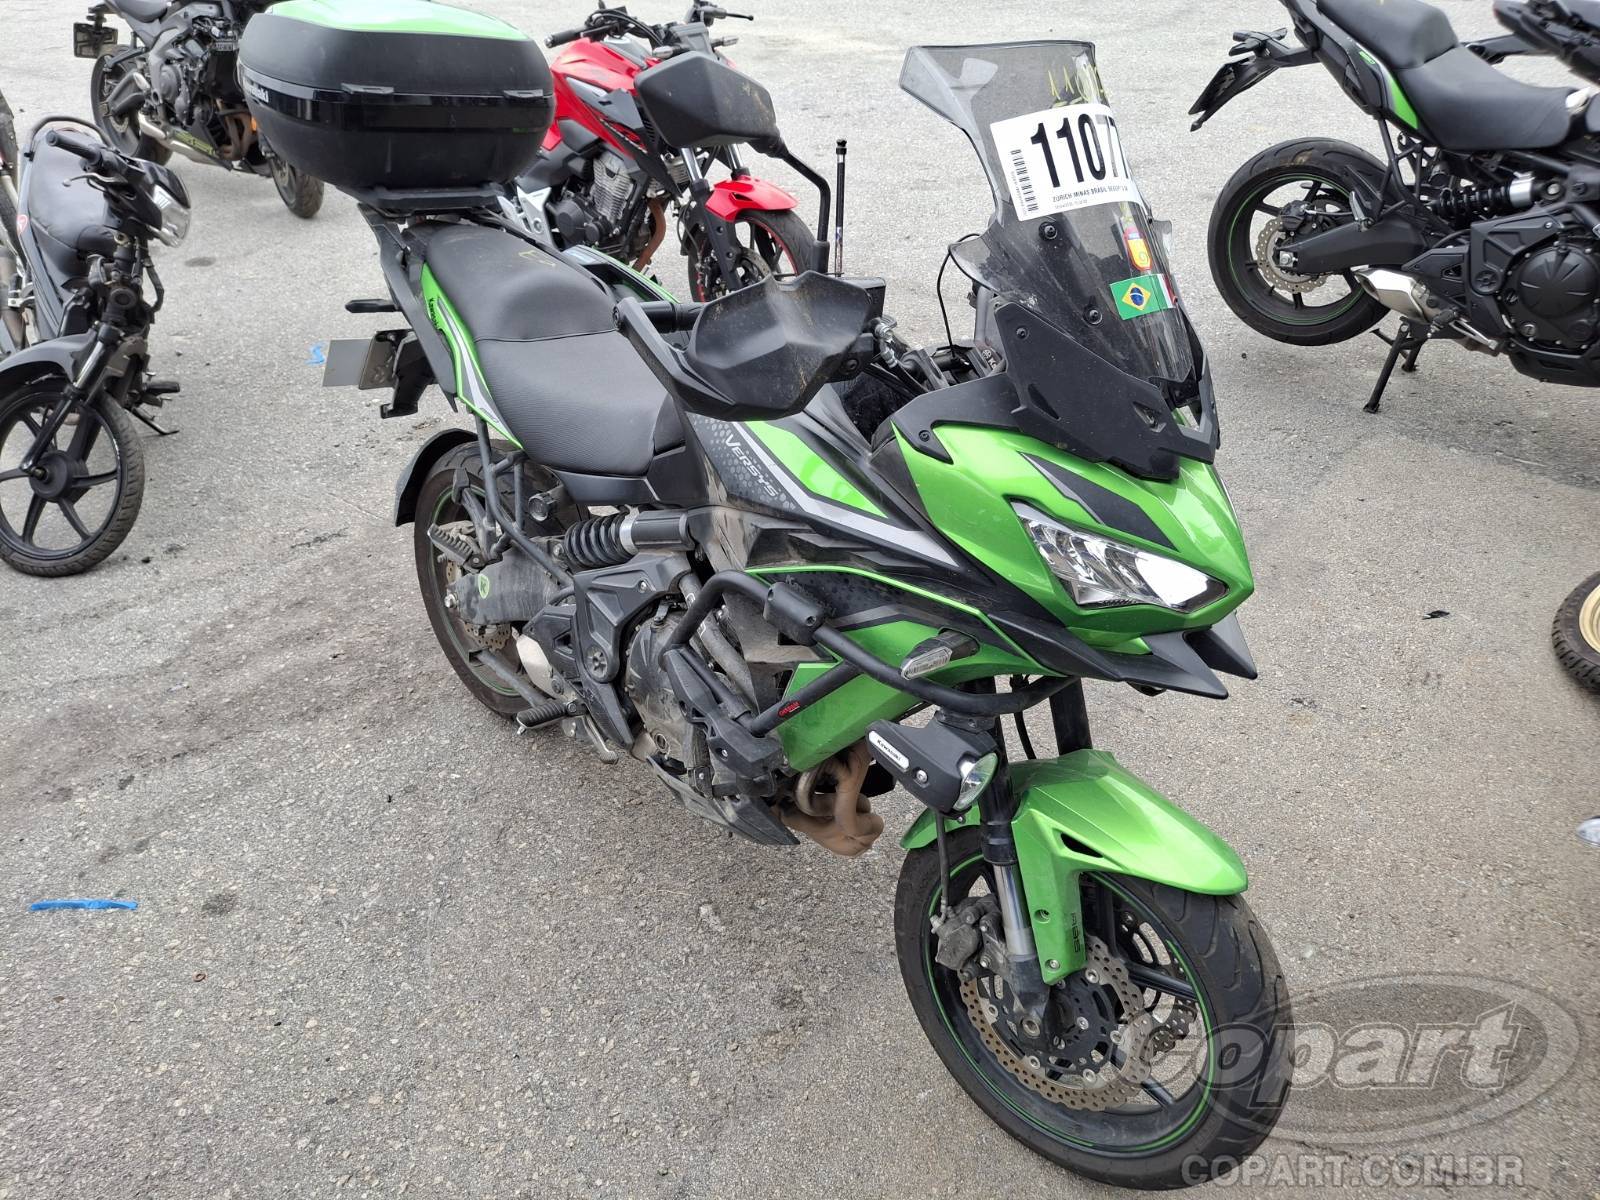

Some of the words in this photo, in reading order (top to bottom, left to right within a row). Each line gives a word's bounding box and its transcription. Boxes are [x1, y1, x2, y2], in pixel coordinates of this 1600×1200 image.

[1074, 189, 1090, 198] MINAS
[1091, 186, 1108, 195] BRASIL
[725, 433, 779, 497] VERSYS
[876, 738, 903, 761] Kawasaki
[1070, 911, 1081, 954] ABS
